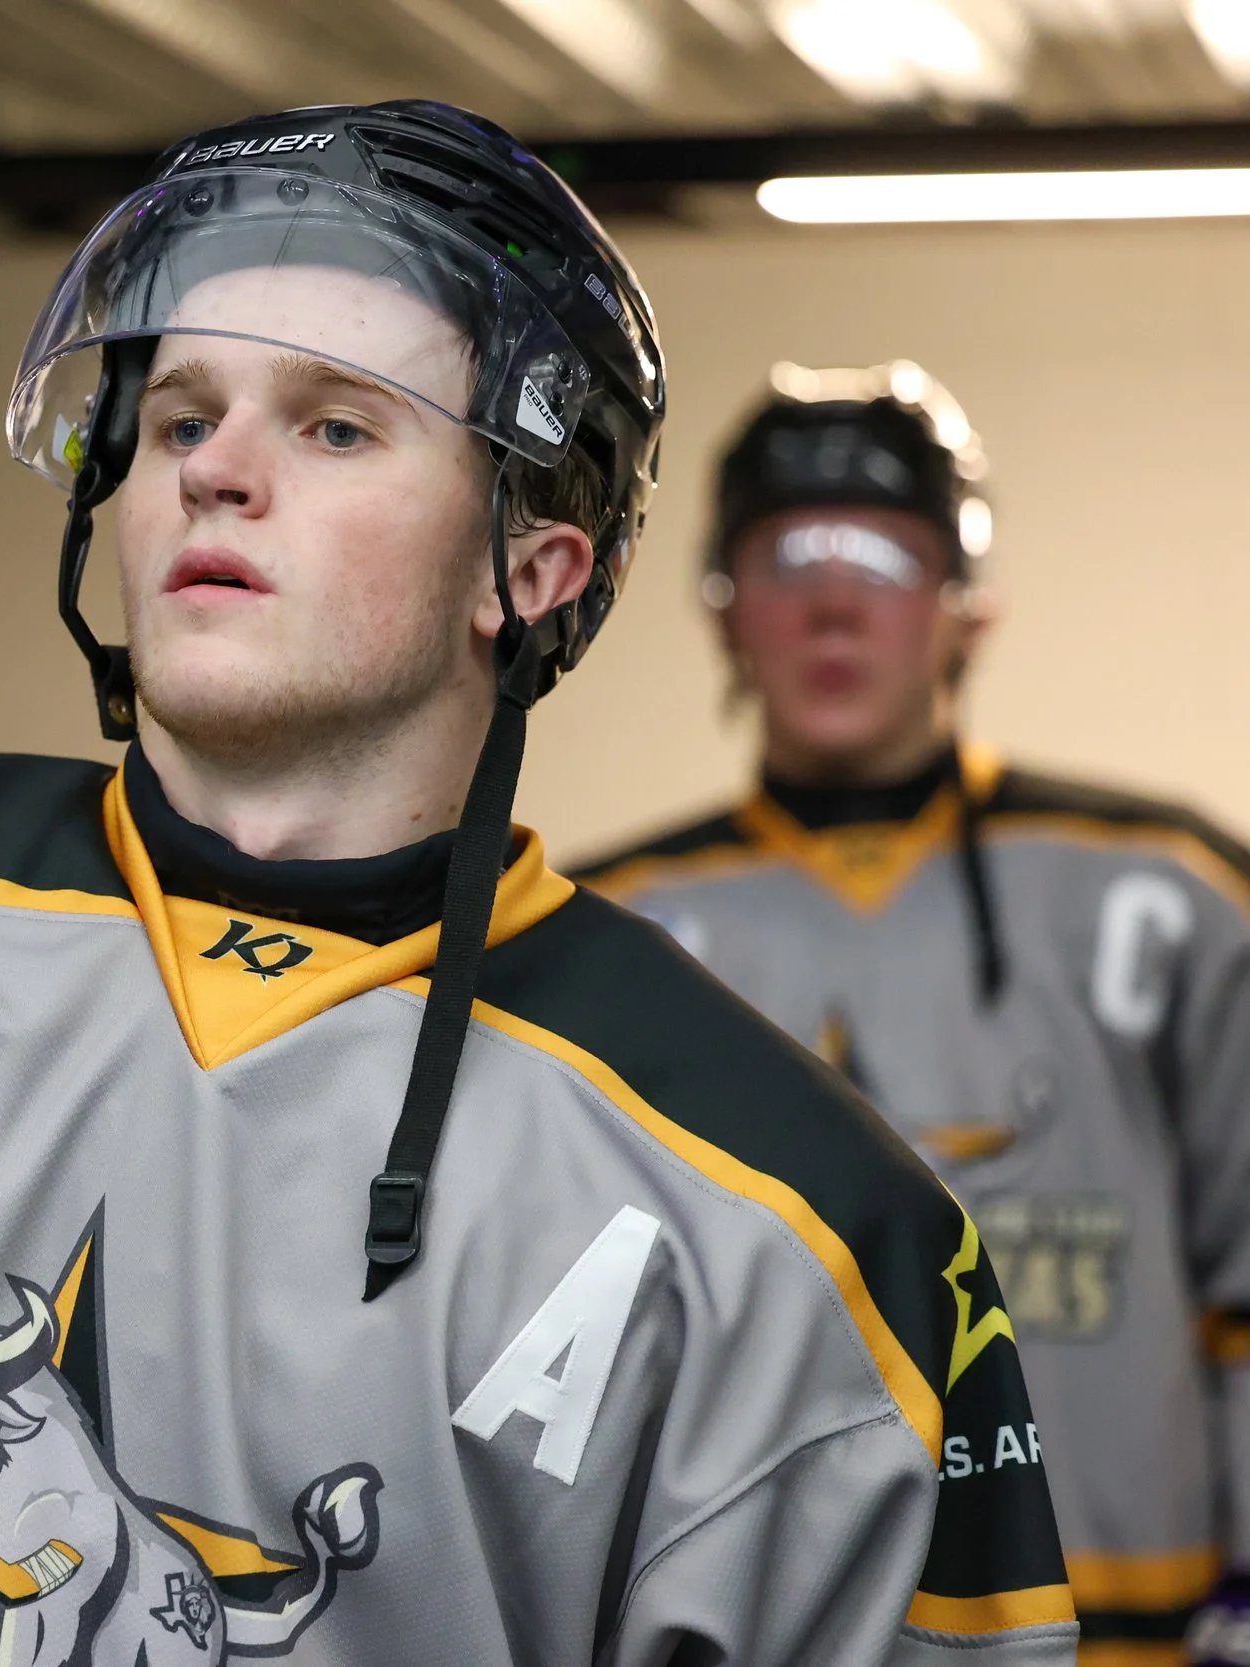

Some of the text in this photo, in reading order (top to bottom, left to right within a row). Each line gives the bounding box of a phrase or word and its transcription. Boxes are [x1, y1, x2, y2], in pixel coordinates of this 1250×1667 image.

[183, 133, 335, 166] BAUER
[525, 384, 562, 438] BAUER
[1095, 870, 1193, 1037] C
[451, 1203, 662, 1486] A
